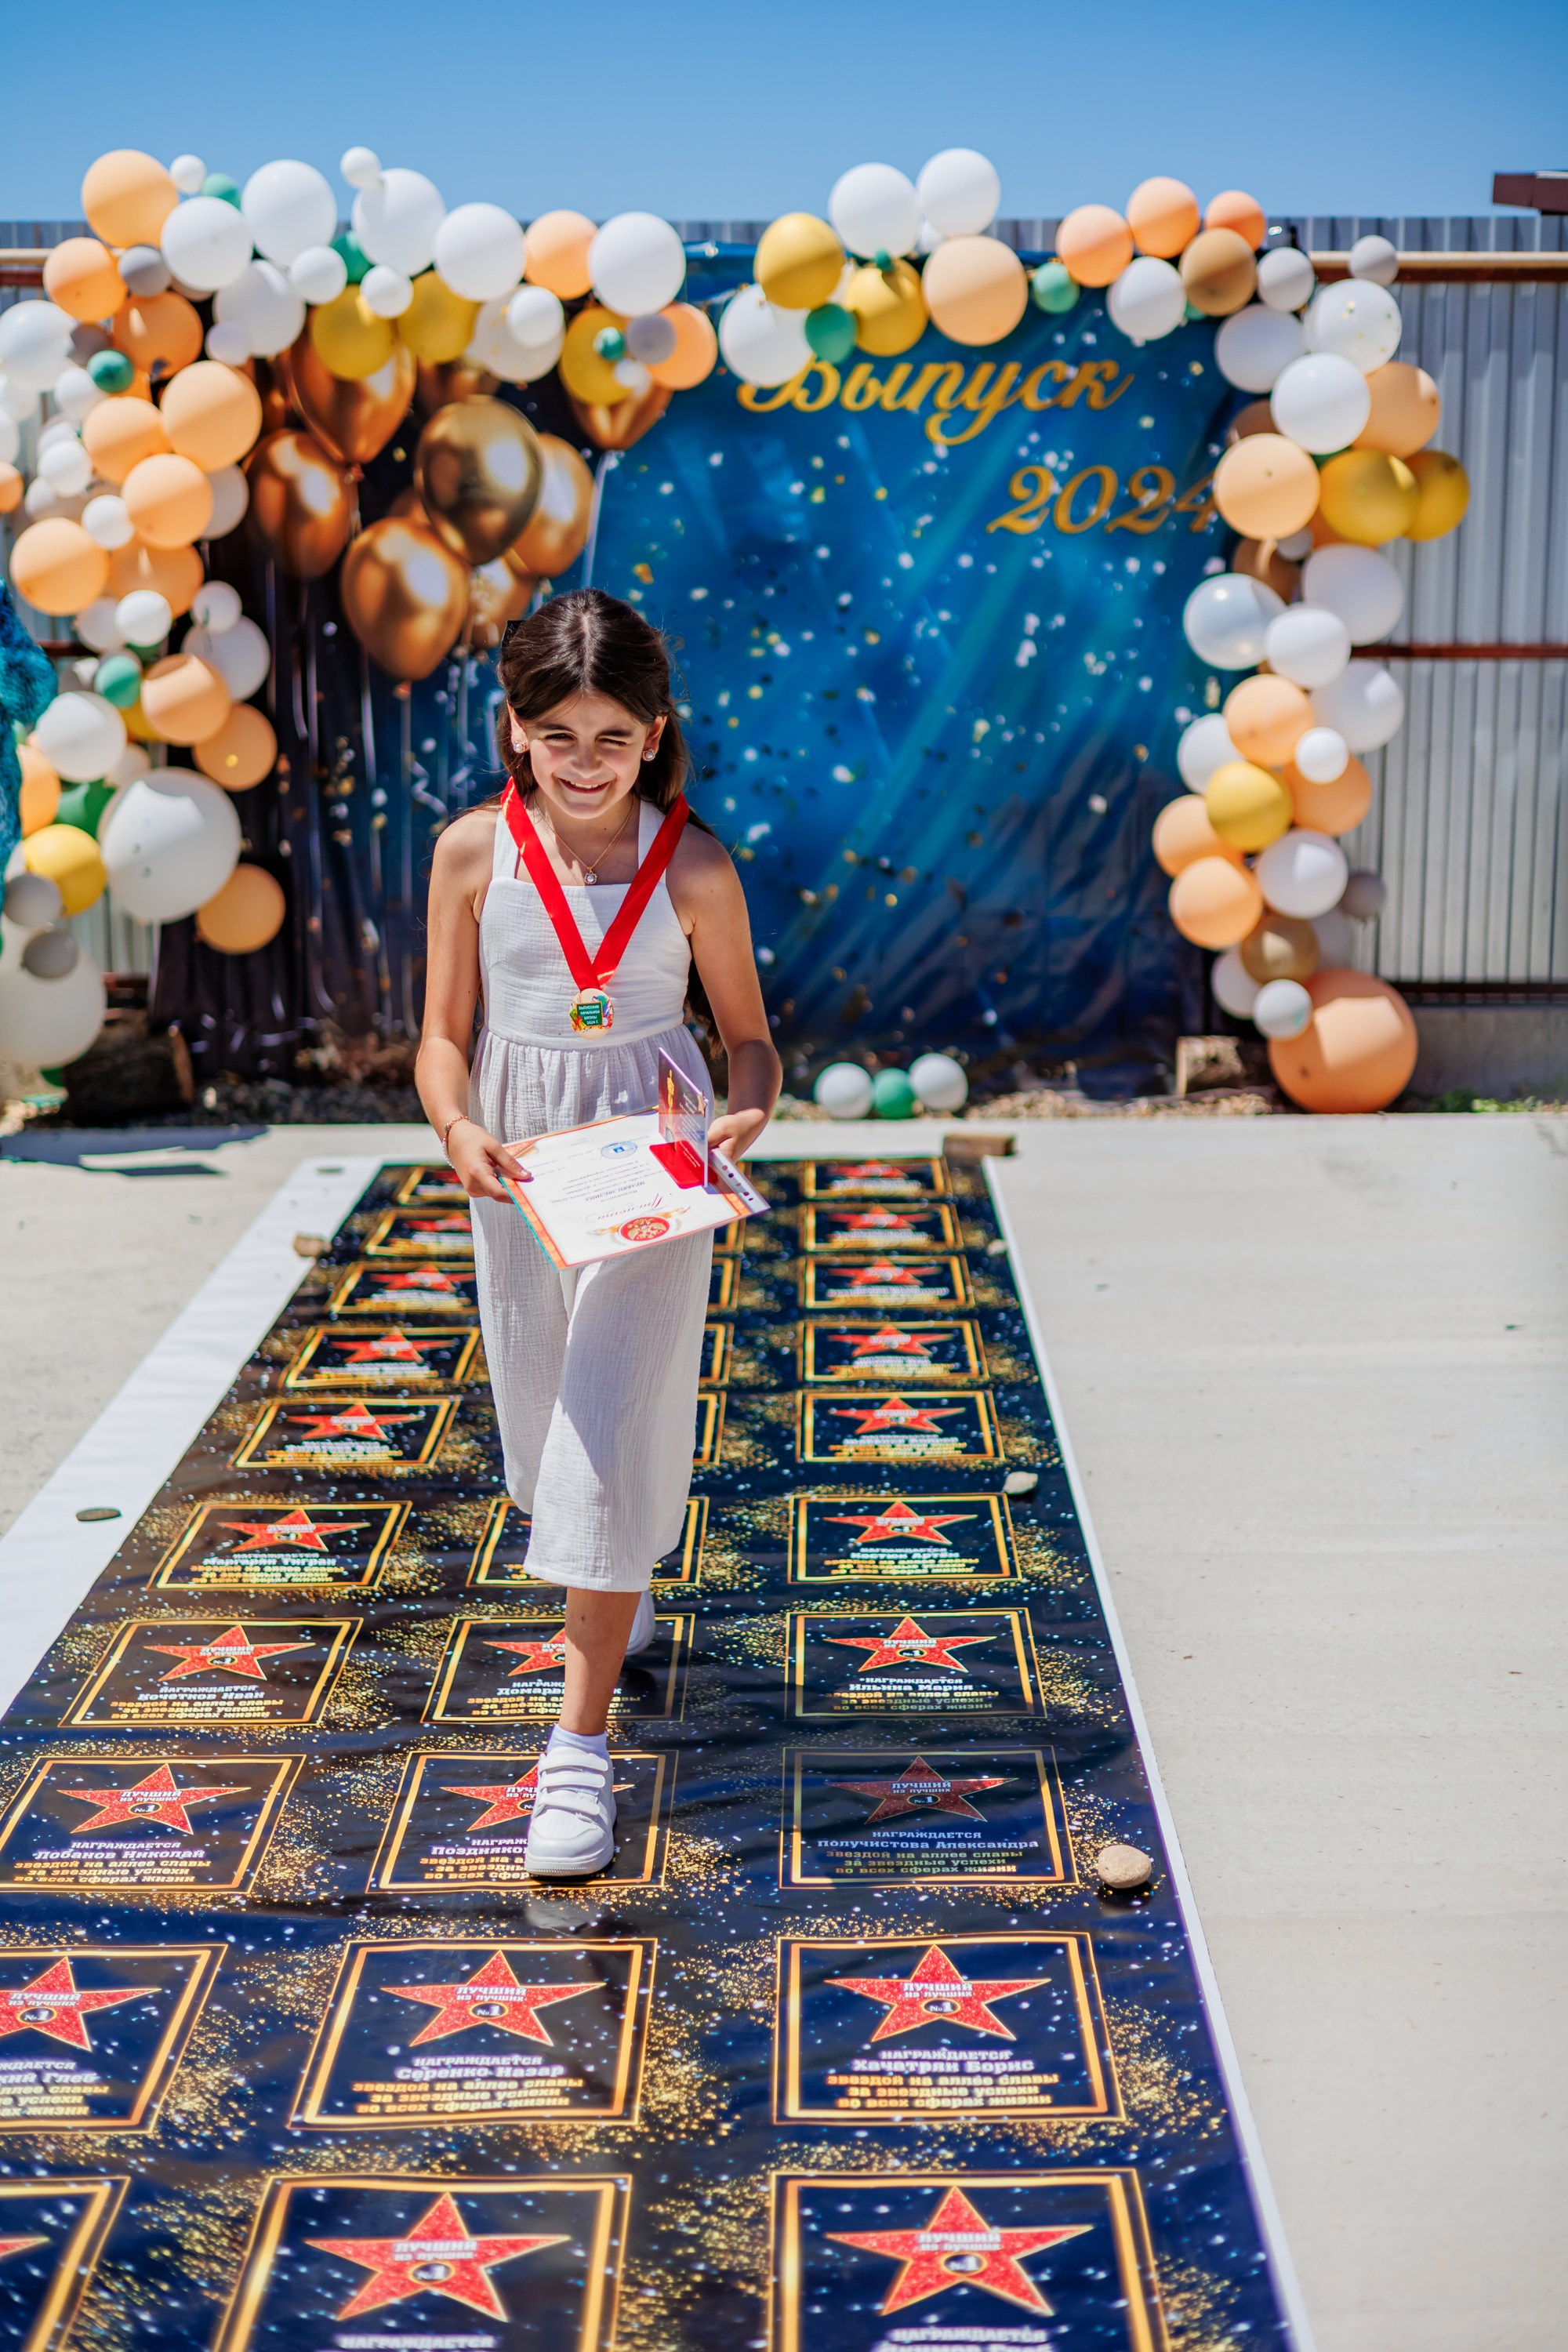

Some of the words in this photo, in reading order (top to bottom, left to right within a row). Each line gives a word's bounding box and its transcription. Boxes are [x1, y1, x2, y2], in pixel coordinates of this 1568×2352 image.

[735, 357, 1134, 446] Выпуск
[986, 465, 1218, 535] 2024
[34, 1849, 116, 1860] Лобанов
[122, 1850, 205, 1859] Николай
[431, 1846, 527, 1856] Поздняко
[134, 1867, 190, 1876] успехи
[456, 1987, 527, 1995] ЛУЧШИЙ
[903, 1982, 972, 1991] ЛУЧШИЙ
[413, 2055, 543, 2067] НАГРАЖДАЕТСЯ
[880, 2050, 1011, 2060] НАГРАЖДАЕТСЯ
[0, 2061, 77, 2070] ЖДАЕТСЯ
[852, 2060, 959, 2074] Хачатрян
[965, 2060, 1034, 2074] Борис
[42, 2072, 97, 2083] Глеб
[396, 2067, 488, 2081] Серенко
[495, 2065, 564, 2078] Назар
[353, 2082, 430, 2092] звездой
[434, 2082, 458, 2091] на
[463, 2081, 518, 2089] аллее
[523, 2079, 583, 2088] славы
[827, 2075, 904, 2085] звездой
[909, 2076, 933, 2085] на
[937, 2075, 993, 2085] аллее
[998, 2074, 1059, 2085] славы
[398, 2091, 490, 2102] звездные
[495, 2088, 561, 2100] успехи
[848, 2087, 871, 2096] за
[876, 2087, 969, 2097] звездные
[973, 2085, 1039, 2097] успехи
[18, 2096, 84, 2107] успехи
[357, 2104, 380, 2113] во
[385, 2103, 428, 2113] всех
[433, 2101, 502, 2112] сферах
[507, 2097, 570, 2107] жизни
[837, 2098, 861, 2108] во
[866, 2098, 909, 2107] всех
[913, 2097, 985, 2109] сферах
[989, 2095, 1051, 2106] жизни
[26, 2106, 89, 2115] жизни
[892, 2327, 1047, 2343] НАГРАЖДАЕТСЯ
[340, 2335, 495, 2349] НАГРАЖДАЕТСЯ
